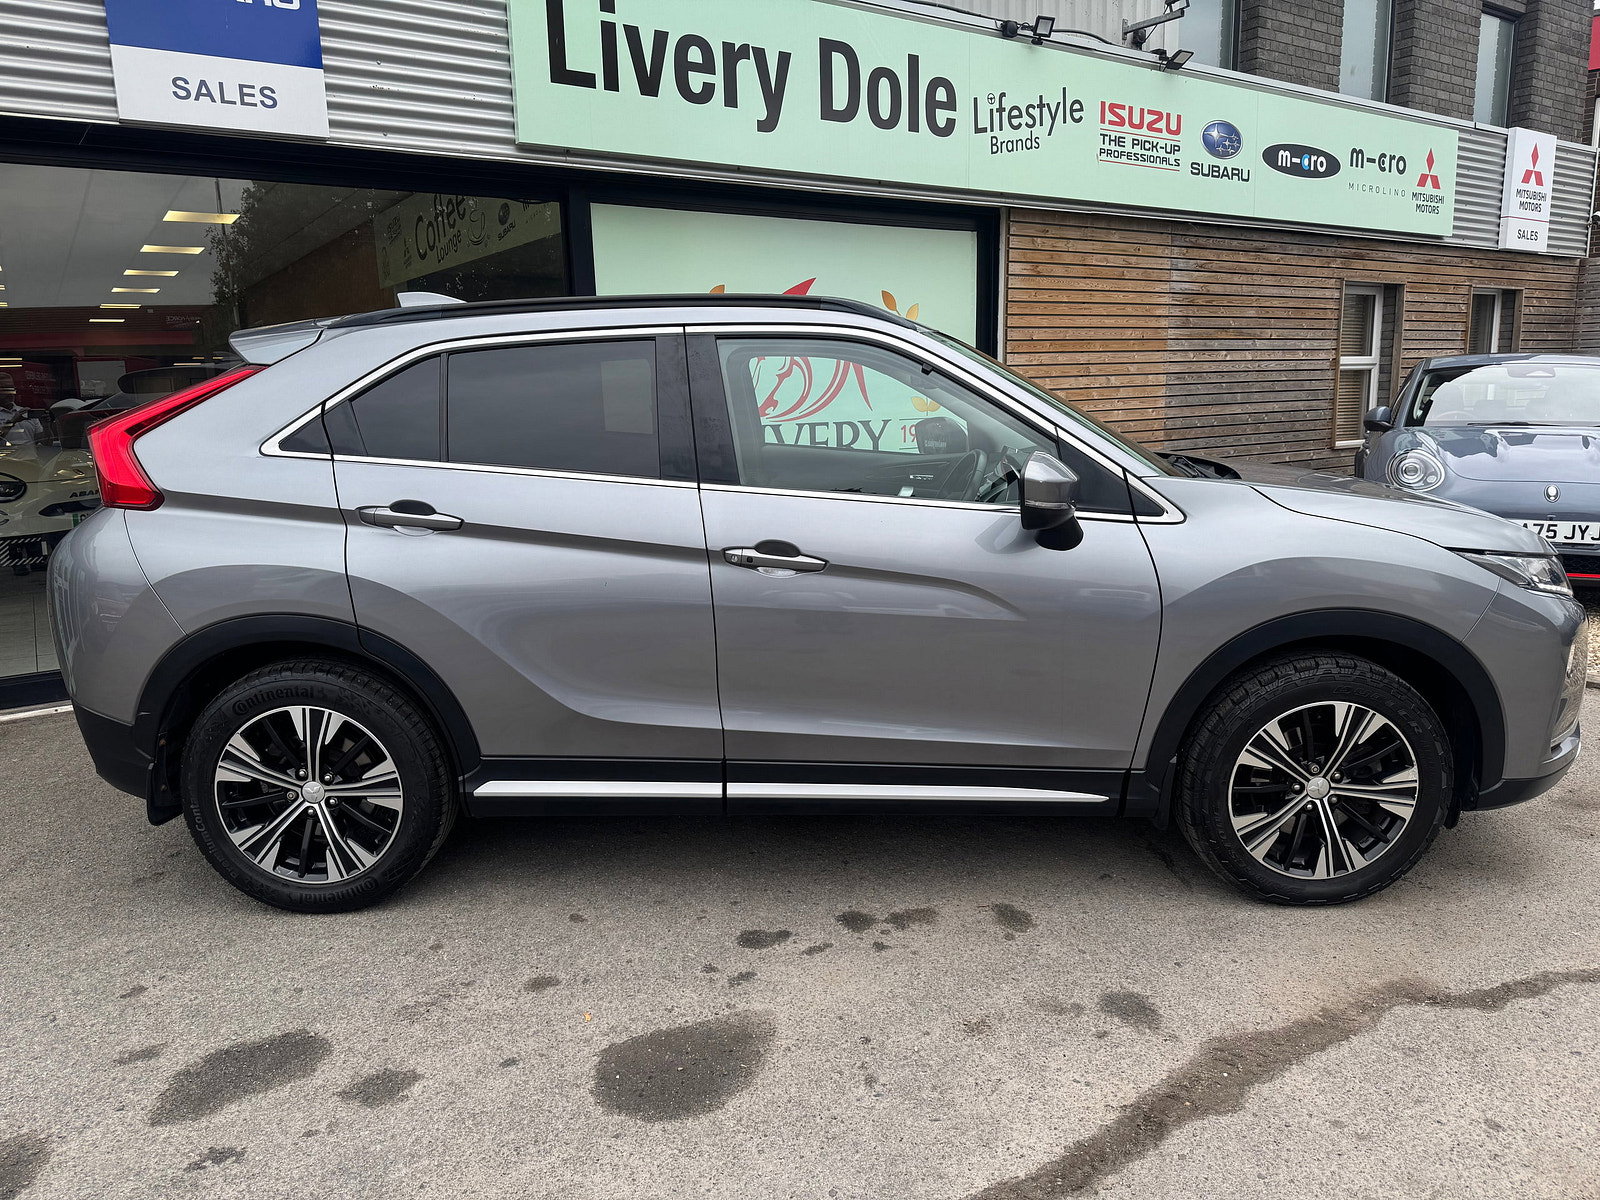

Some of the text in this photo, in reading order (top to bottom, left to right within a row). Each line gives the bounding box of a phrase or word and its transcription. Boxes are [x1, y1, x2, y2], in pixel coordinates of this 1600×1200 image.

[547, 0, 957, 138] Livery Dole
[172, 76, 278, 109] SALES
[973, 87, 1084, 136] Lifestyle
[1100, 100, 1182, 136] ISUZU
[990, 130, 1040, 155] Brands
[1100, 133, 1181, 156] THE PICK-UP
[1099, 147, 1181, 167] PROFESSIONALS
[1190, 162, 1250, 182] SUBARU
[1348, 182, 1406, 197] MICROLINO
[1411, 191, 1445, 205] MITSUBISHI
[1515, 188, 1548, 202] MITSUBISHI
[1415, 203, 1440, 215] MOTORS
[1518, 200, 1542, 213] MOTORS
[1517, 228, 1539, 242] SALES
[435, 229, 463, 264] Lounge
